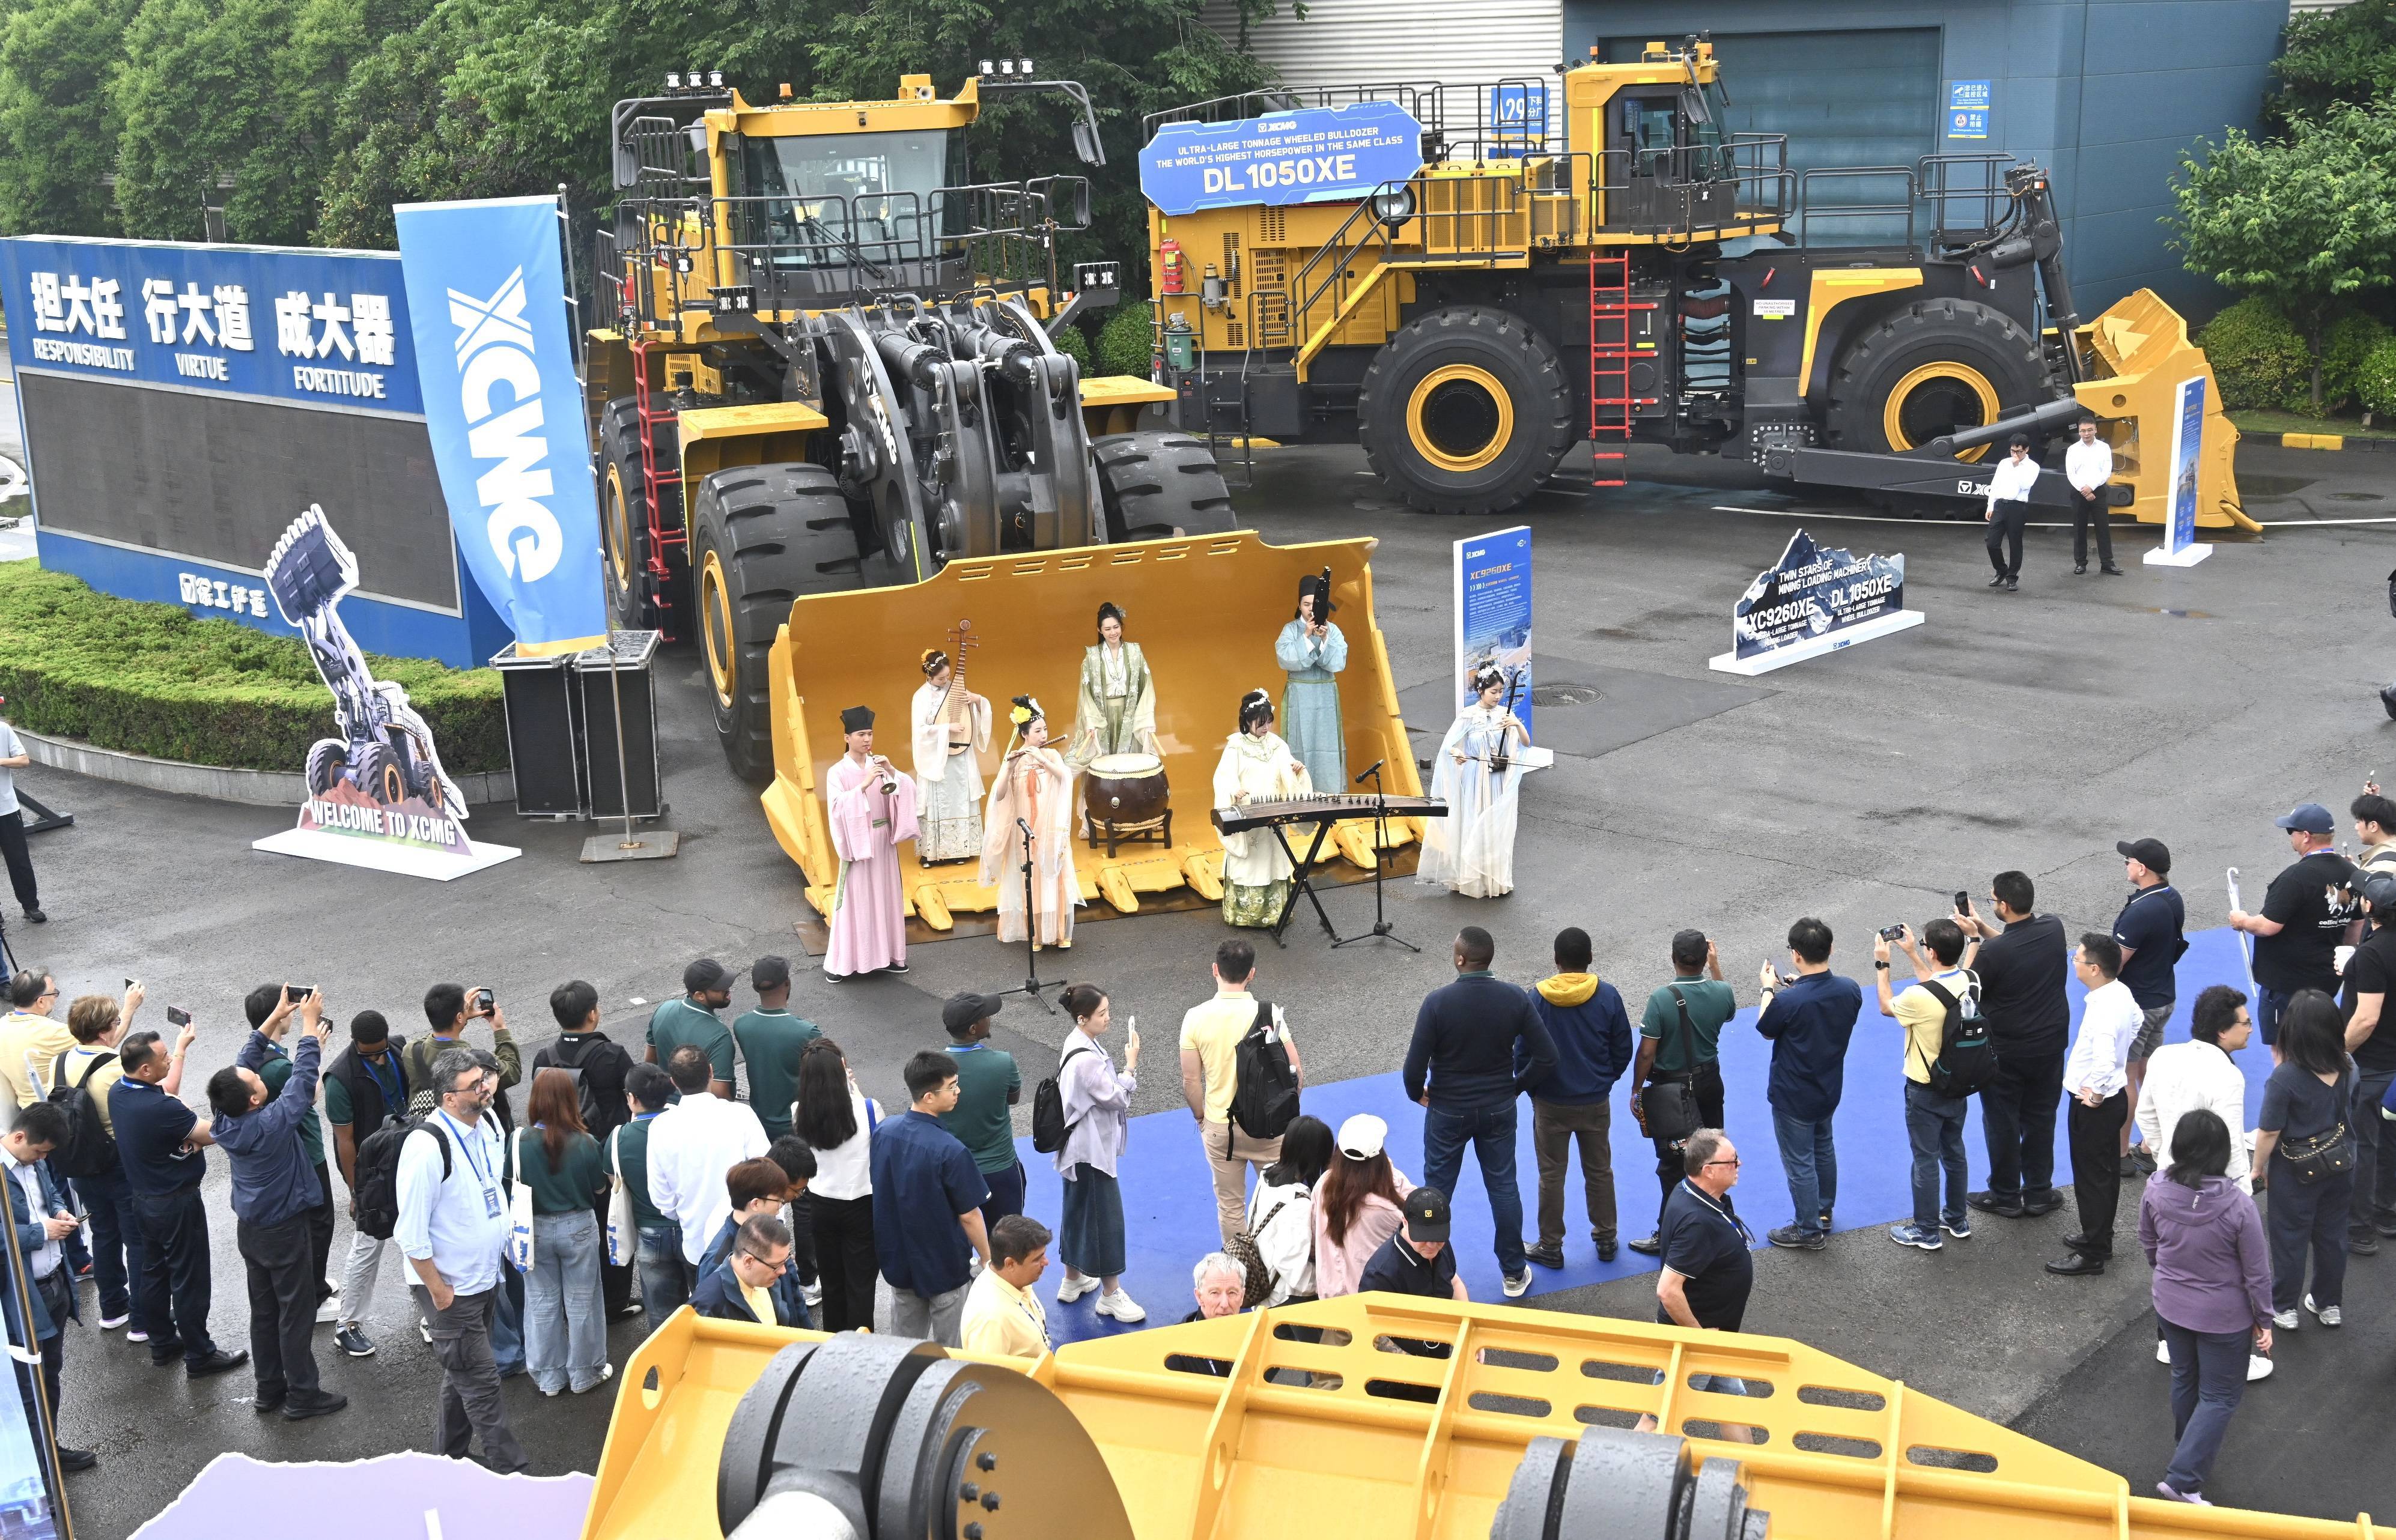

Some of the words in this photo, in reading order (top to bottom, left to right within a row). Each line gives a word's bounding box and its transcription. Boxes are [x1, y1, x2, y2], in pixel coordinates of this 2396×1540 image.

[1494, 98, 1525, 125] A29
[1268, 120, 1297, 132] XCMG
[1156, 159, 1173, 169] THE
[1175, 154, 1214, 167] WORLD'S
[1215, 151, 1252, 163] HIGHEST
[1254, 145, 1313, 160] HORSEPOWER
[1315, 143, 1325, 152] IN
[1327, 141, 1344, 151] THE
[1346, 139, 1372, 150] SAME
[1373, 135, 1403, 147] CLASS
[1178, 141, 1239, 155] ULTRA-LARGE
[1241, 137, 1282, 148] TONNAGE
[1284, 132, 1326, 145] WHEELED
[1327, 127, 1379, 140] BULLDOZER
[31, 271, 127, 340] 担大任
[141, 277, 255, 351] 行大道
[275, 291, 395, 366] 成大器
[33, 338, 135, 371] RESPONSIBILITY
[175, 353, 230, 381] VIRTUE
[293, 366, 386, 399] FORTITUDE
[869, 380, 897, 465] XCMG
[1471, 549, 1486, 559] XCMG
[1470, 563, 1512, 581] XC9260XE
[1778, 579, 1801, 596] MINING
[1802, 571, 1832, 589] LOADING
[1834, 561, 1871, 580] MACHINERY
[1779, 571, 1797, 583] TWIN
[1798, 563, 1823, 579] STARS
[1823, 559, 1834, 571] OF
[1748, 596, 1816, 634] XC9260XE
[1837, 603, 1867, 617] ULTRA-LARGE
[1867, 596, 1886, 608] TONNAGE
[1841, 613, 1856, 623] WHEEL
[1856, 606, 1881, 620] BULLDOZER
[1781, 631, 1798, 642] LOADER
[1788, 620, 1808, 631] TONNAGE
[1837, 640, 1850, 649] XCMG
[311, 799, 385, 835] WELCOME
[388, 810, 407, 837] TO
[410, 817, 457, 846] XCMG
[1249, 1031, 1262, 1039] Targus
